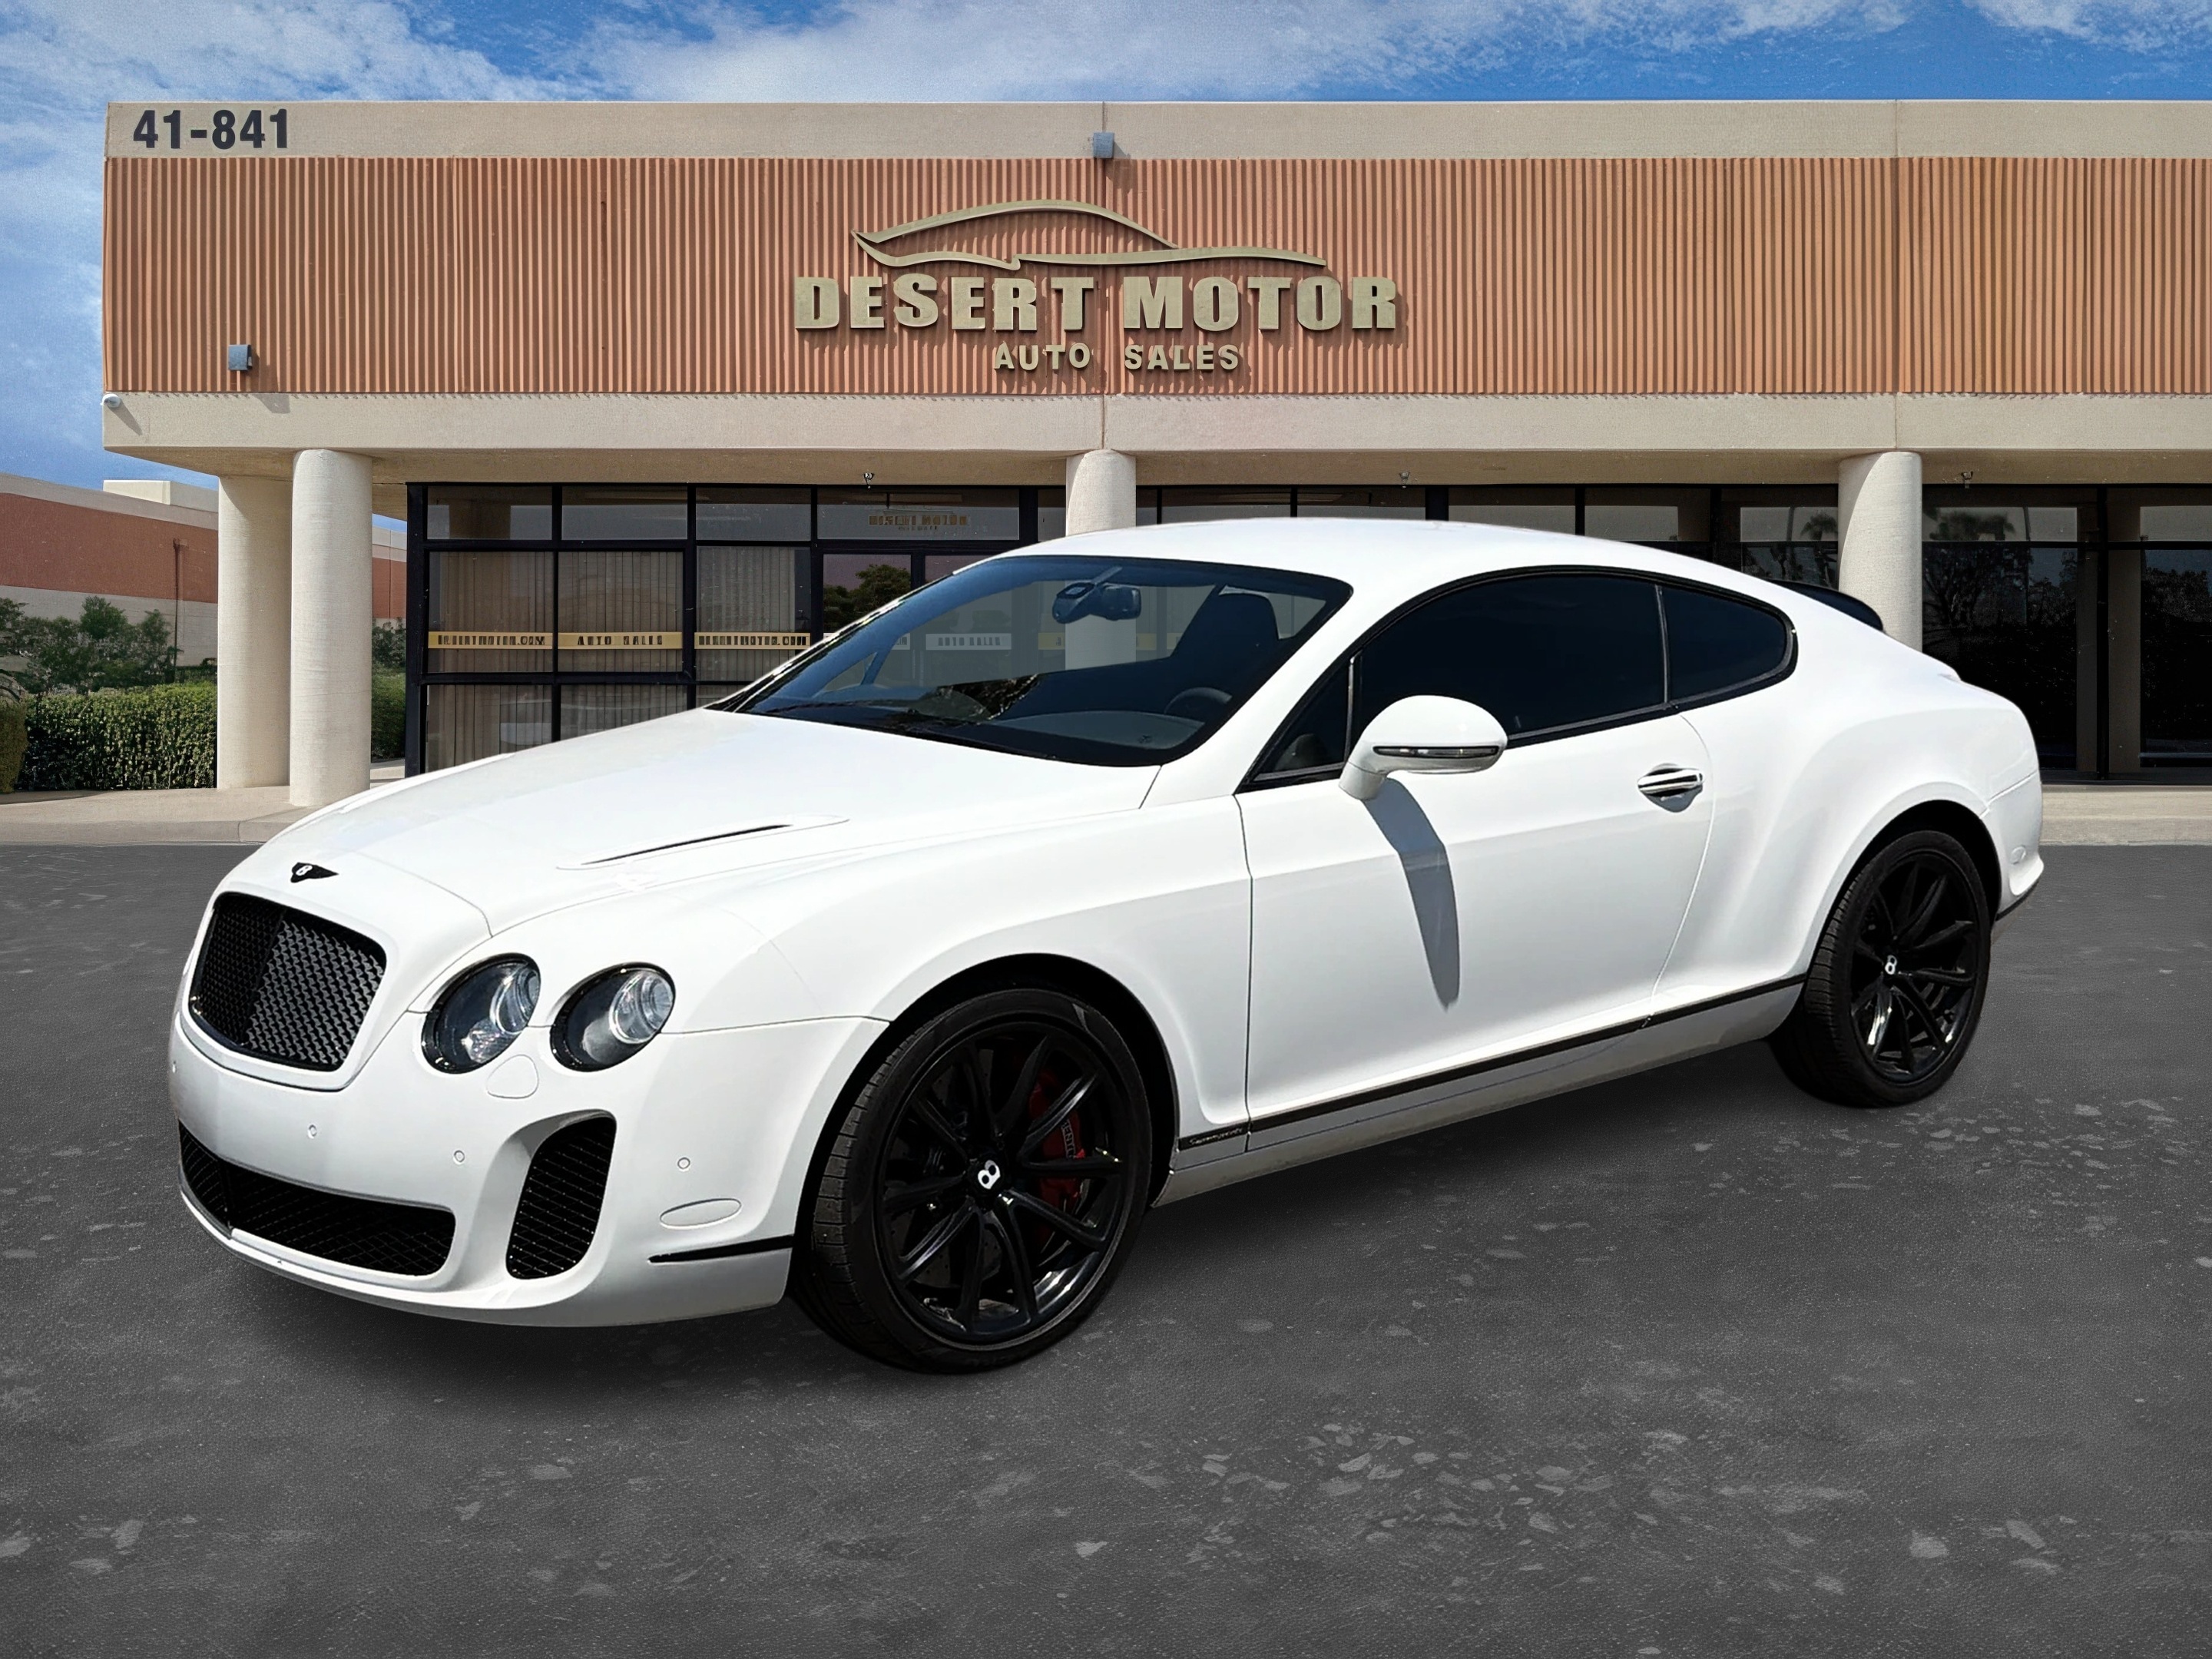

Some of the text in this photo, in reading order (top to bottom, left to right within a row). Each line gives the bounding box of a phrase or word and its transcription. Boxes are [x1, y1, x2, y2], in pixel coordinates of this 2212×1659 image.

[133, 108, 288, 150] 41-841
[793, 273, 1396, 332] DESERT MOTOR
[993, 342, 1240, 373] AUTO SALES
